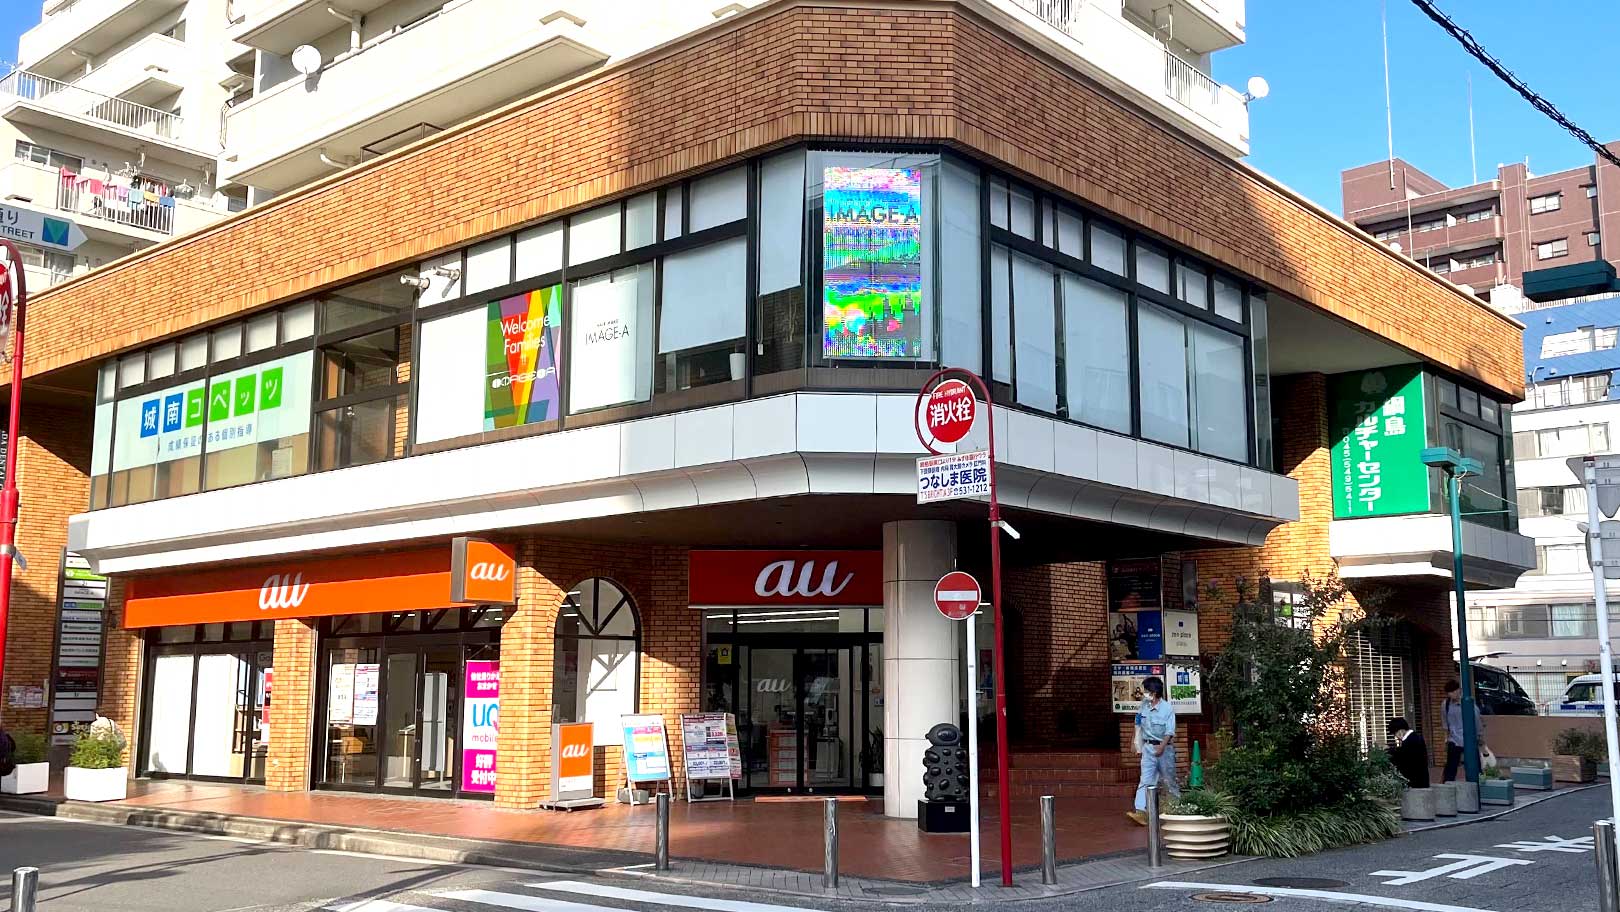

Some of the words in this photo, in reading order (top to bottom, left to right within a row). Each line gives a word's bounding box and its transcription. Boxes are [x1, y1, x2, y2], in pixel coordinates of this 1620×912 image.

[0, 208, 18, 225] り
[0, 224, 35, 239] TREET
[500, 314, 550, 337] Welcome
[585, 324, 630, 345] IMAGE-A
[504, 333, 545, 355] Families
[932, 391, 943, 400] FIRE
[944, 385, 966, 397] HYDRANT
[930, 396, 972, 428] 消火栓
[1353, 401, 1382, 511] カルチャーセンター
[920, 467, 987, 490] つなしま医院
[958, 483, 988, 495] 531-1212
[470, 562, 510, 582] au
[755, 559, 854, 597] au
[258, 571, 310, 610] au
[757, 678, 792, 693] au
[472, 703, 499, 731] UQ
[562, 743, 590, 758] au
[471, 769, 497, 786] 受付中
